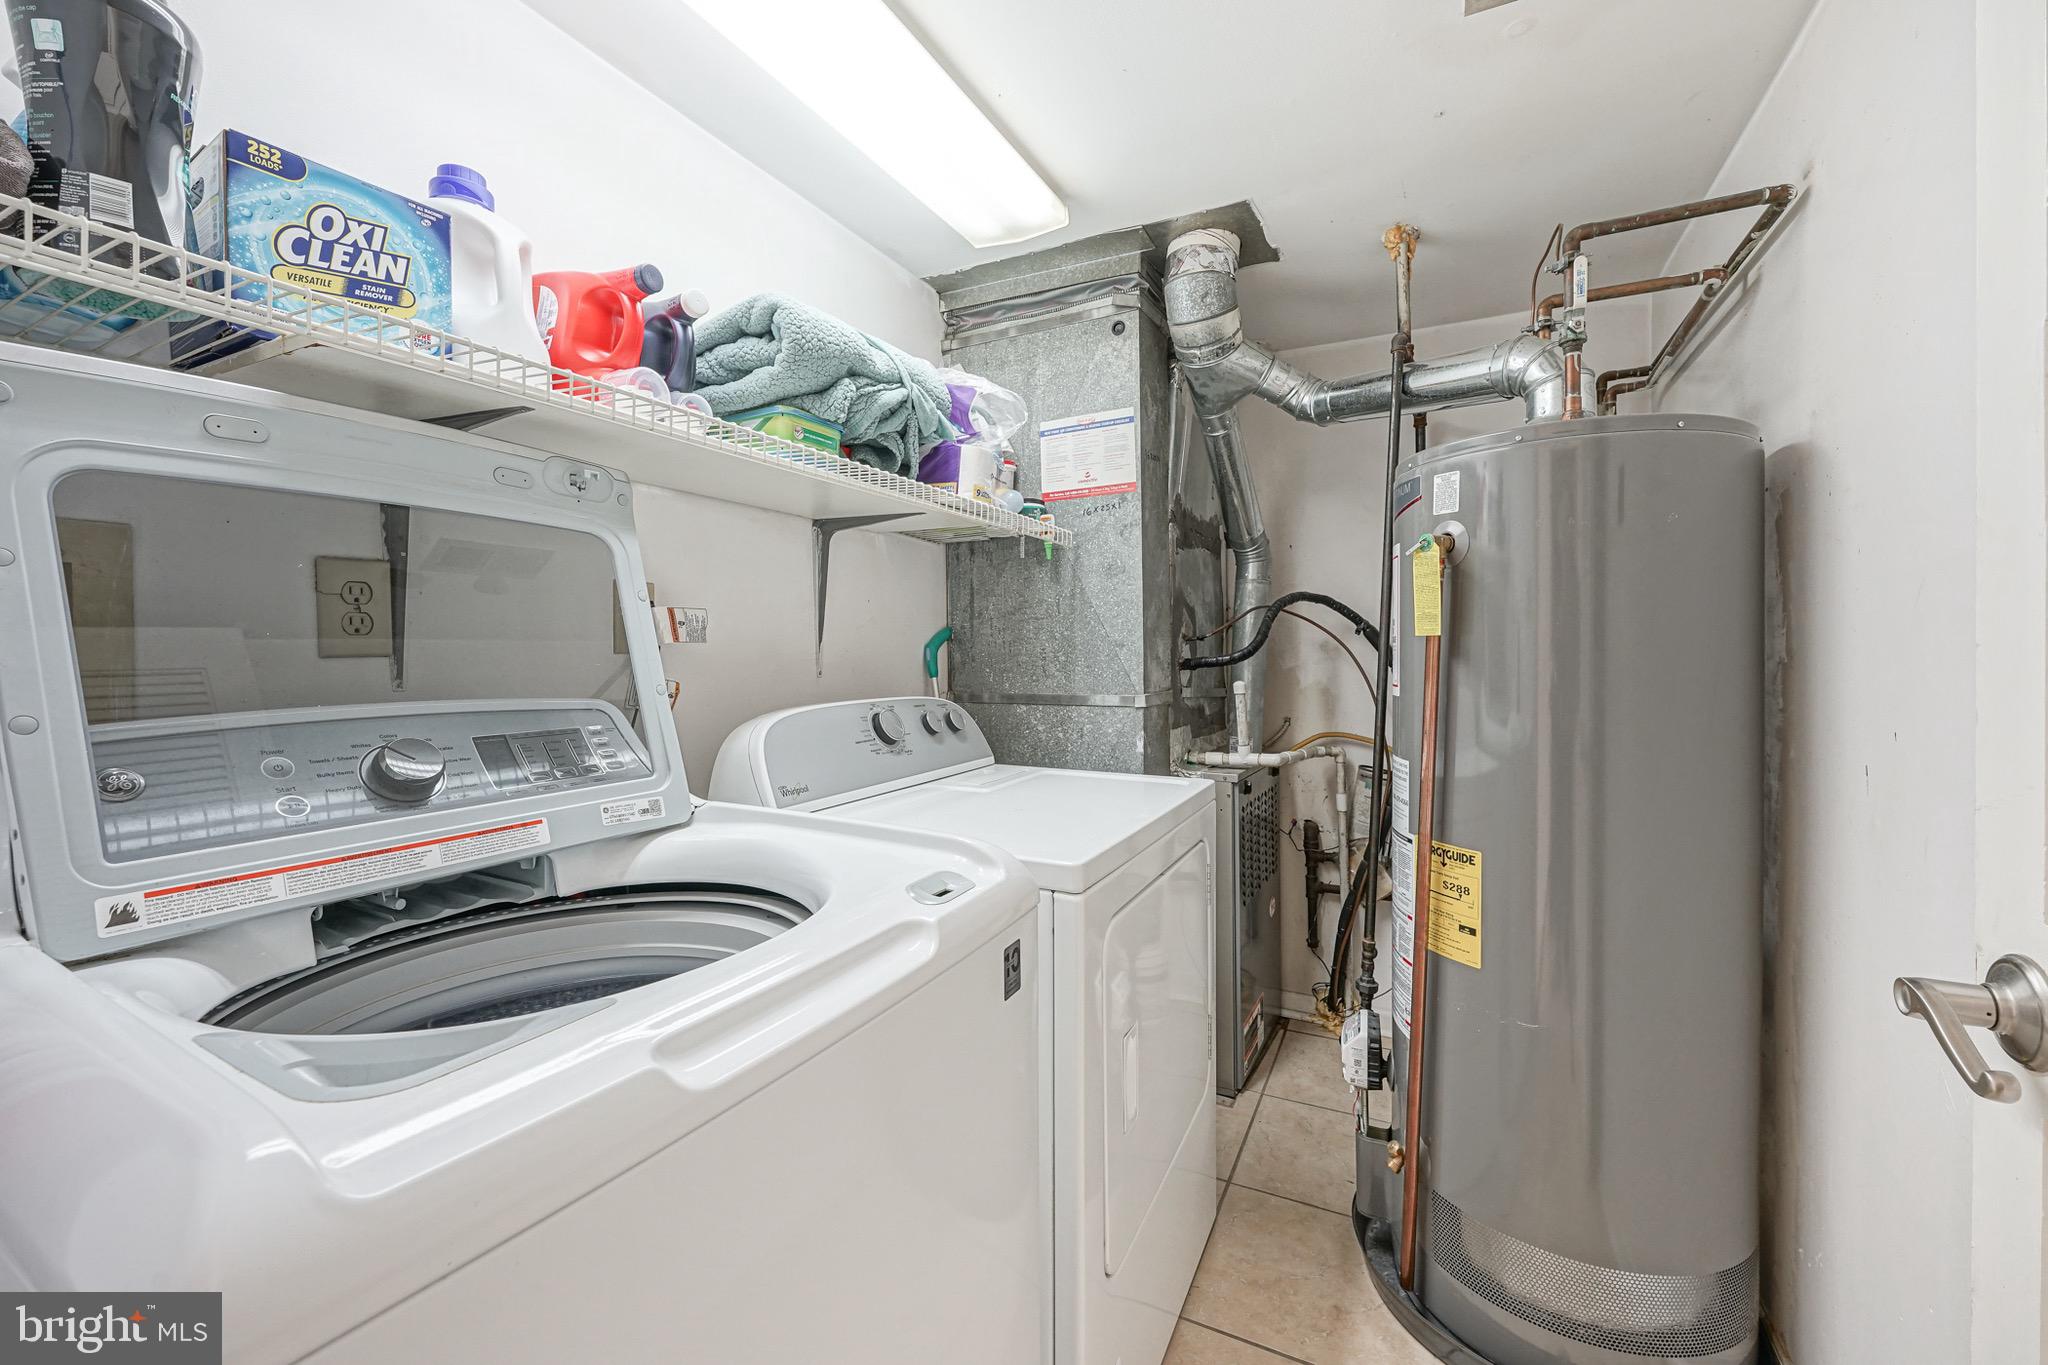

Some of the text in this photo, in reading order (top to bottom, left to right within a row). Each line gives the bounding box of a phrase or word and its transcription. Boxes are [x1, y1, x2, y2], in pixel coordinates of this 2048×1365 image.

[247, 140, 281, 164] 252
[309, 206, 385, 252] OXI
[276, 226, 407, 285] CLEAN
[286, 271, 332, 288] VERSATILE
[355, 290, 393, 302] REMOVER
[362, 284, 386, 294] STAIN
[779, 784, 809, 797] Whirlpool
[1431, 846, 1475, 866] RGYGUIDE
[1442, 880, 1471, 896] $288
